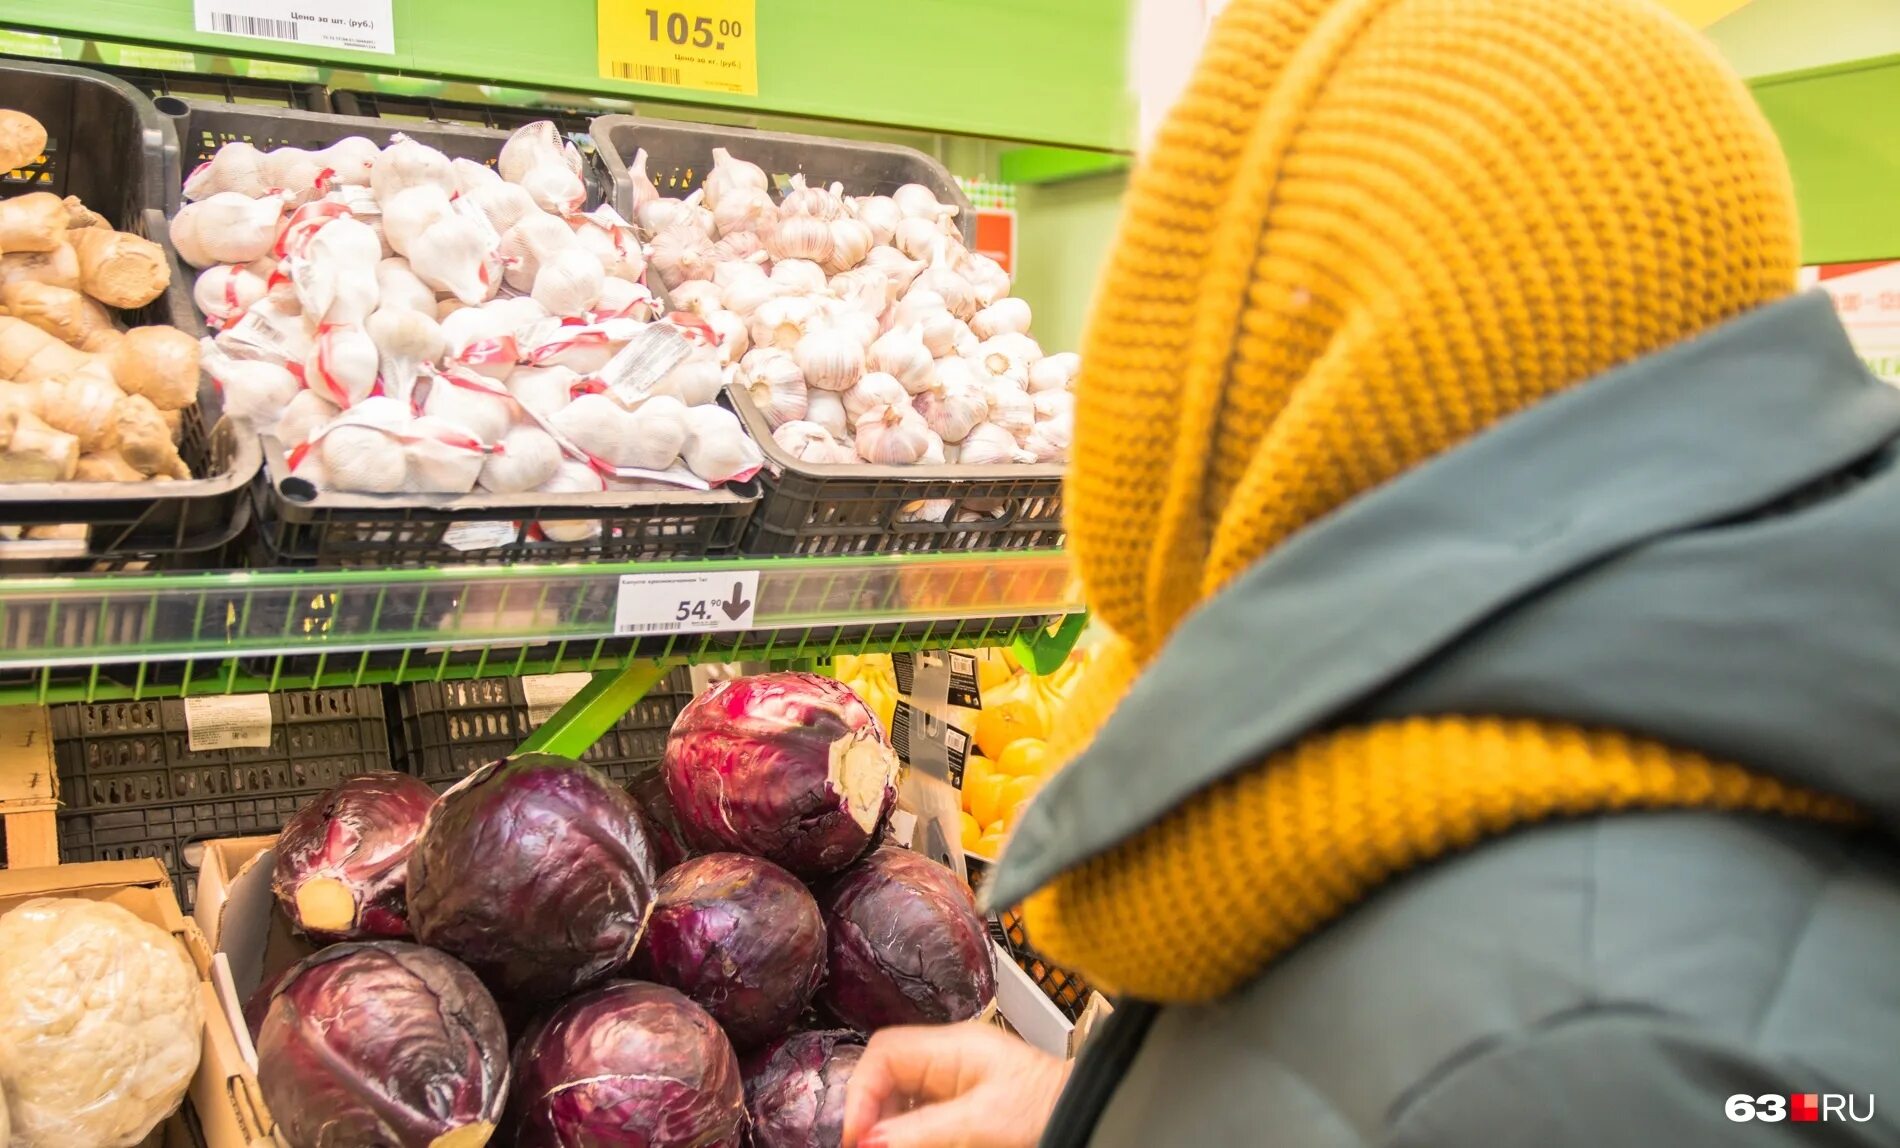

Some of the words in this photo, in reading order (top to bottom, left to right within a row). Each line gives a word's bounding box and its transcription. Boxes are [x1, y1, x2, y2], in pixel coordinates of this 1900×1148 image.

[290, 11, 315, 22] Цена
[331, 17, 346, 25] шт.
[348, 17, 374, 29] (руб.)
